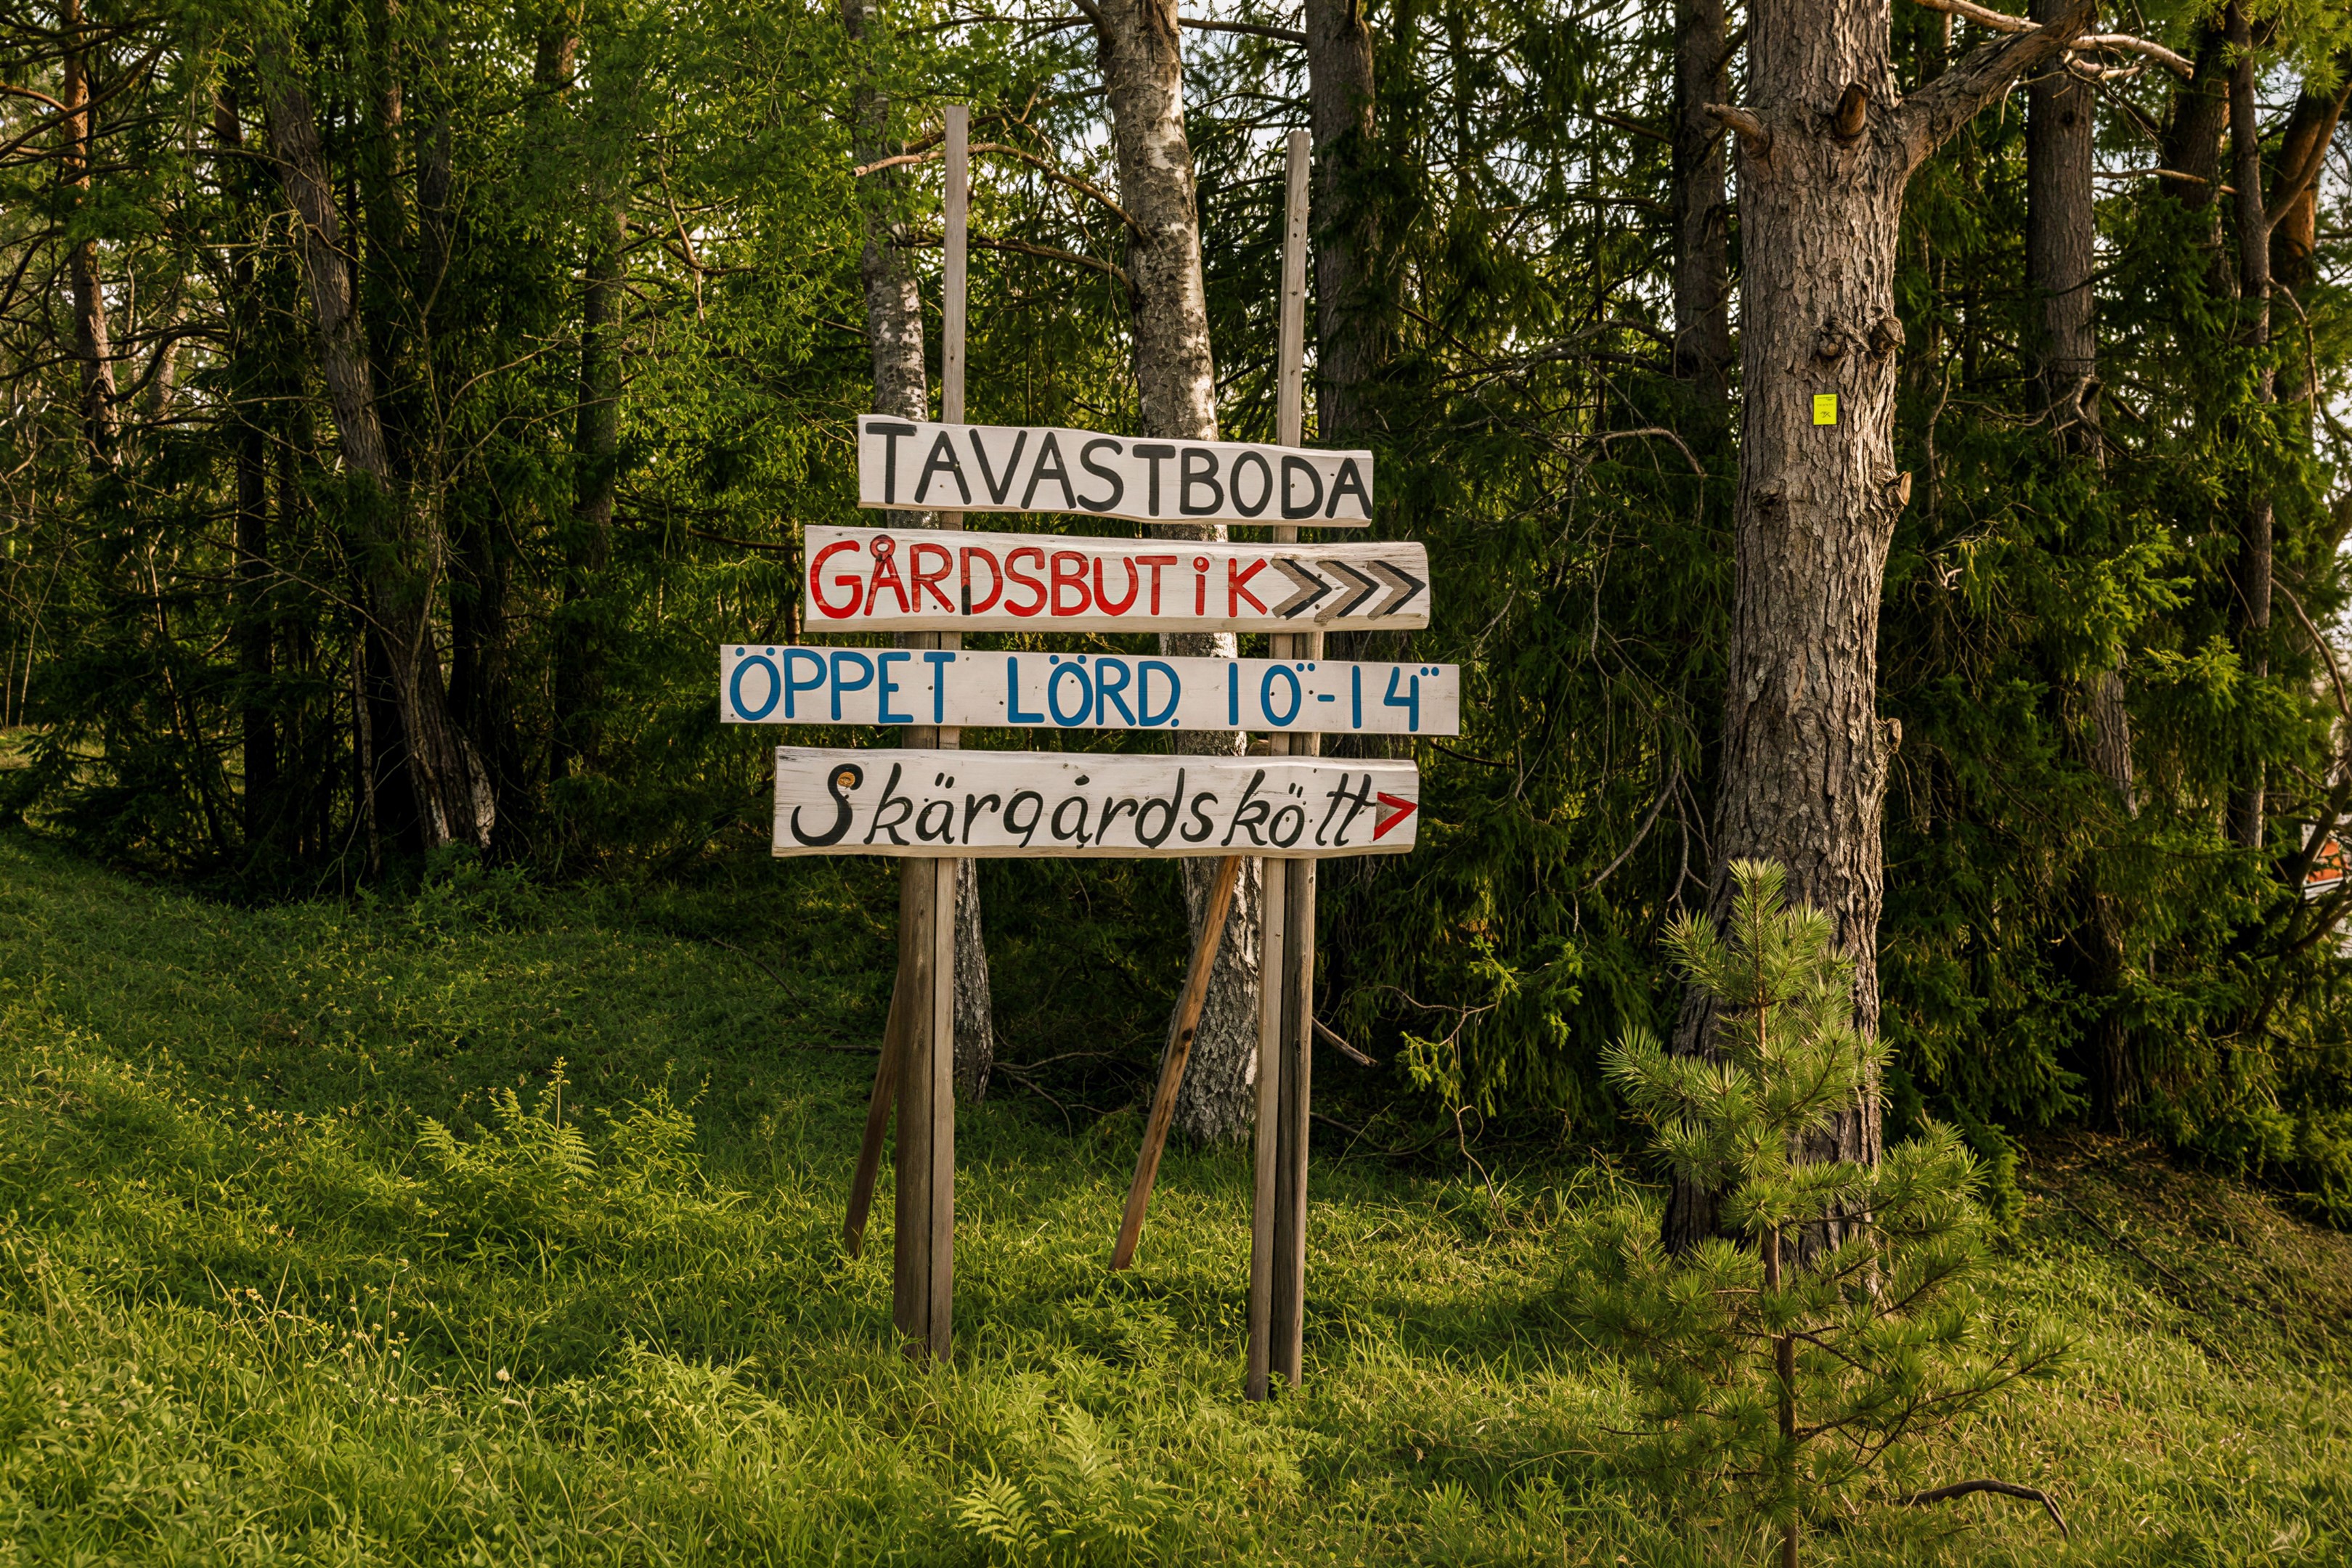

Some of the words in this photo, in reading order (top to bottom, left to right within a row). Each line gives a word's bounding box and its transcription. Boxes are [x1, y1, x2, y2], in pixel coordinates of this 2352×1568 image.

[865, 422, 1372, 520] TAVASTBODA
[730, 647, 956, 724] ÖPPET
[1007, 655, 1180, 727] LÖRD.
